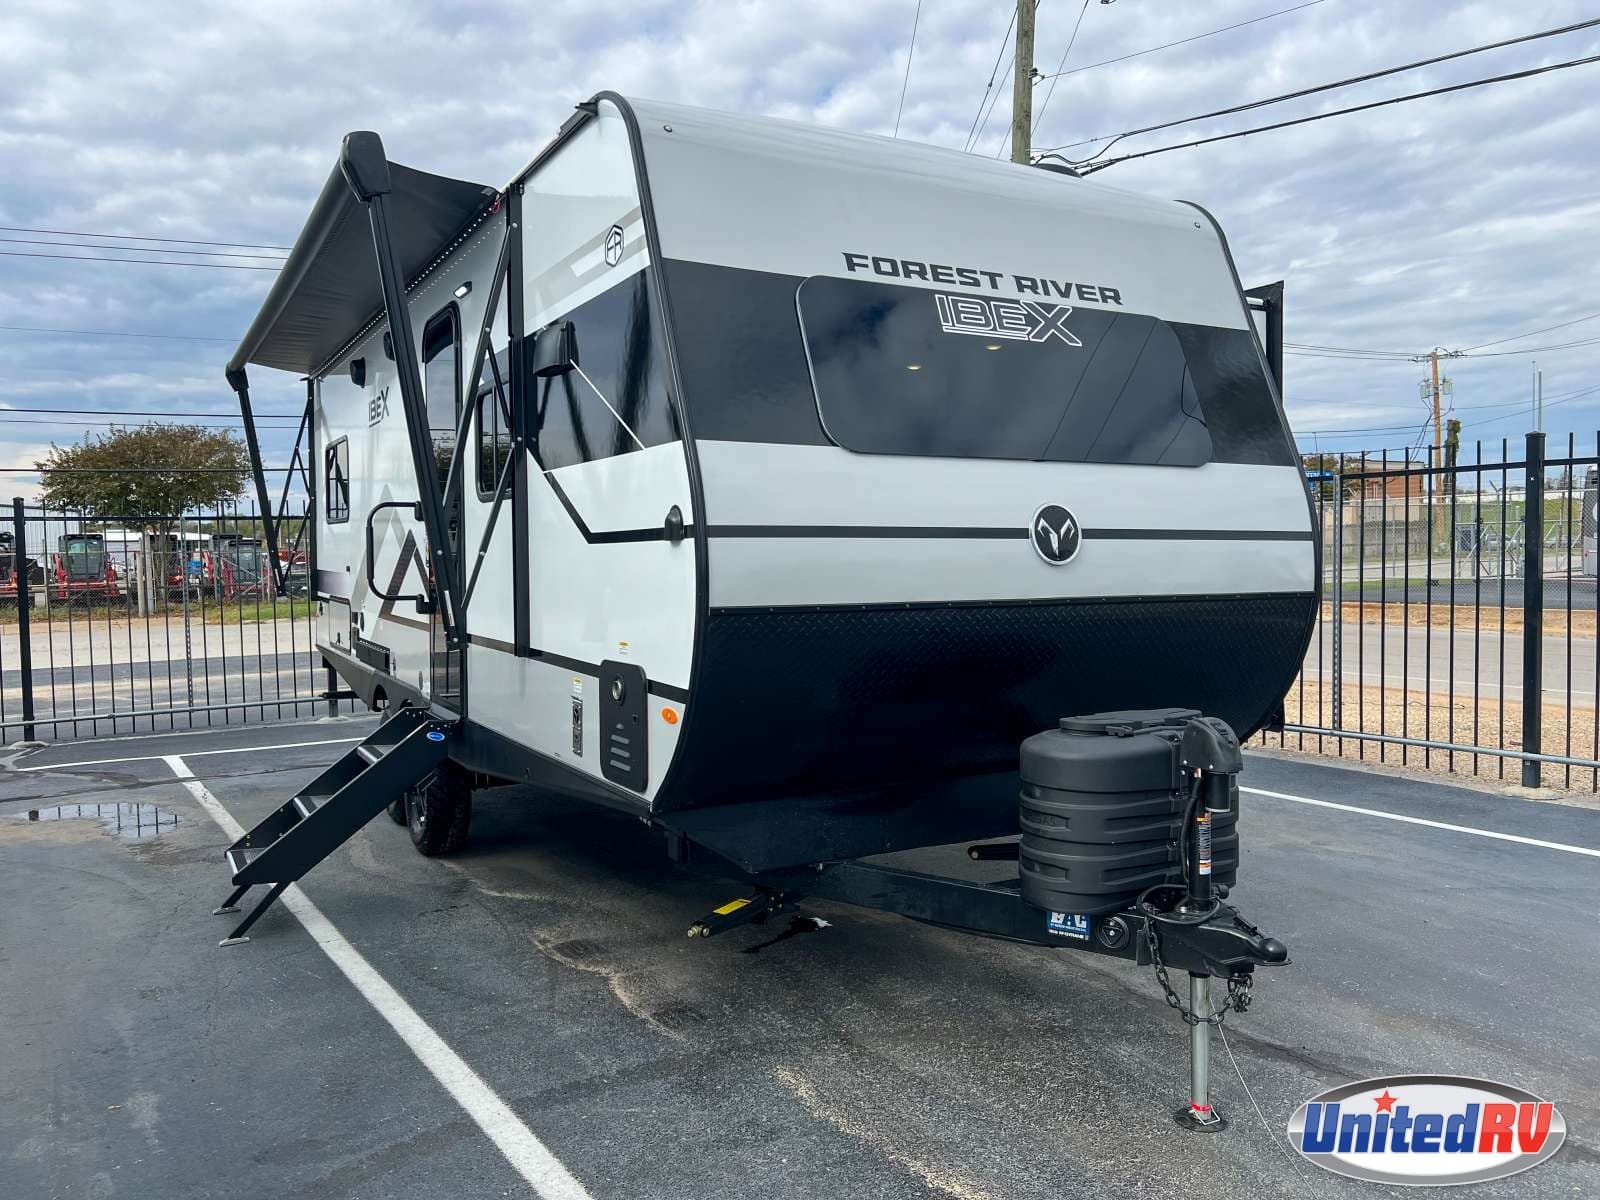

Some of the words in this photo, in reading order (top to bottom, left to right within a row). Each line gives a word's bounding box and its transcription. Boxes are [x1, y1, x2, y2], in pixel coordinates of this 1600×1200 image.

[842, 252, 1003, 290] FOREST
[1012, 274, 1124, 305] RIVER
[934, 293, 1083, 347] IBEX
[368, 385, 389, 428] IBEX
